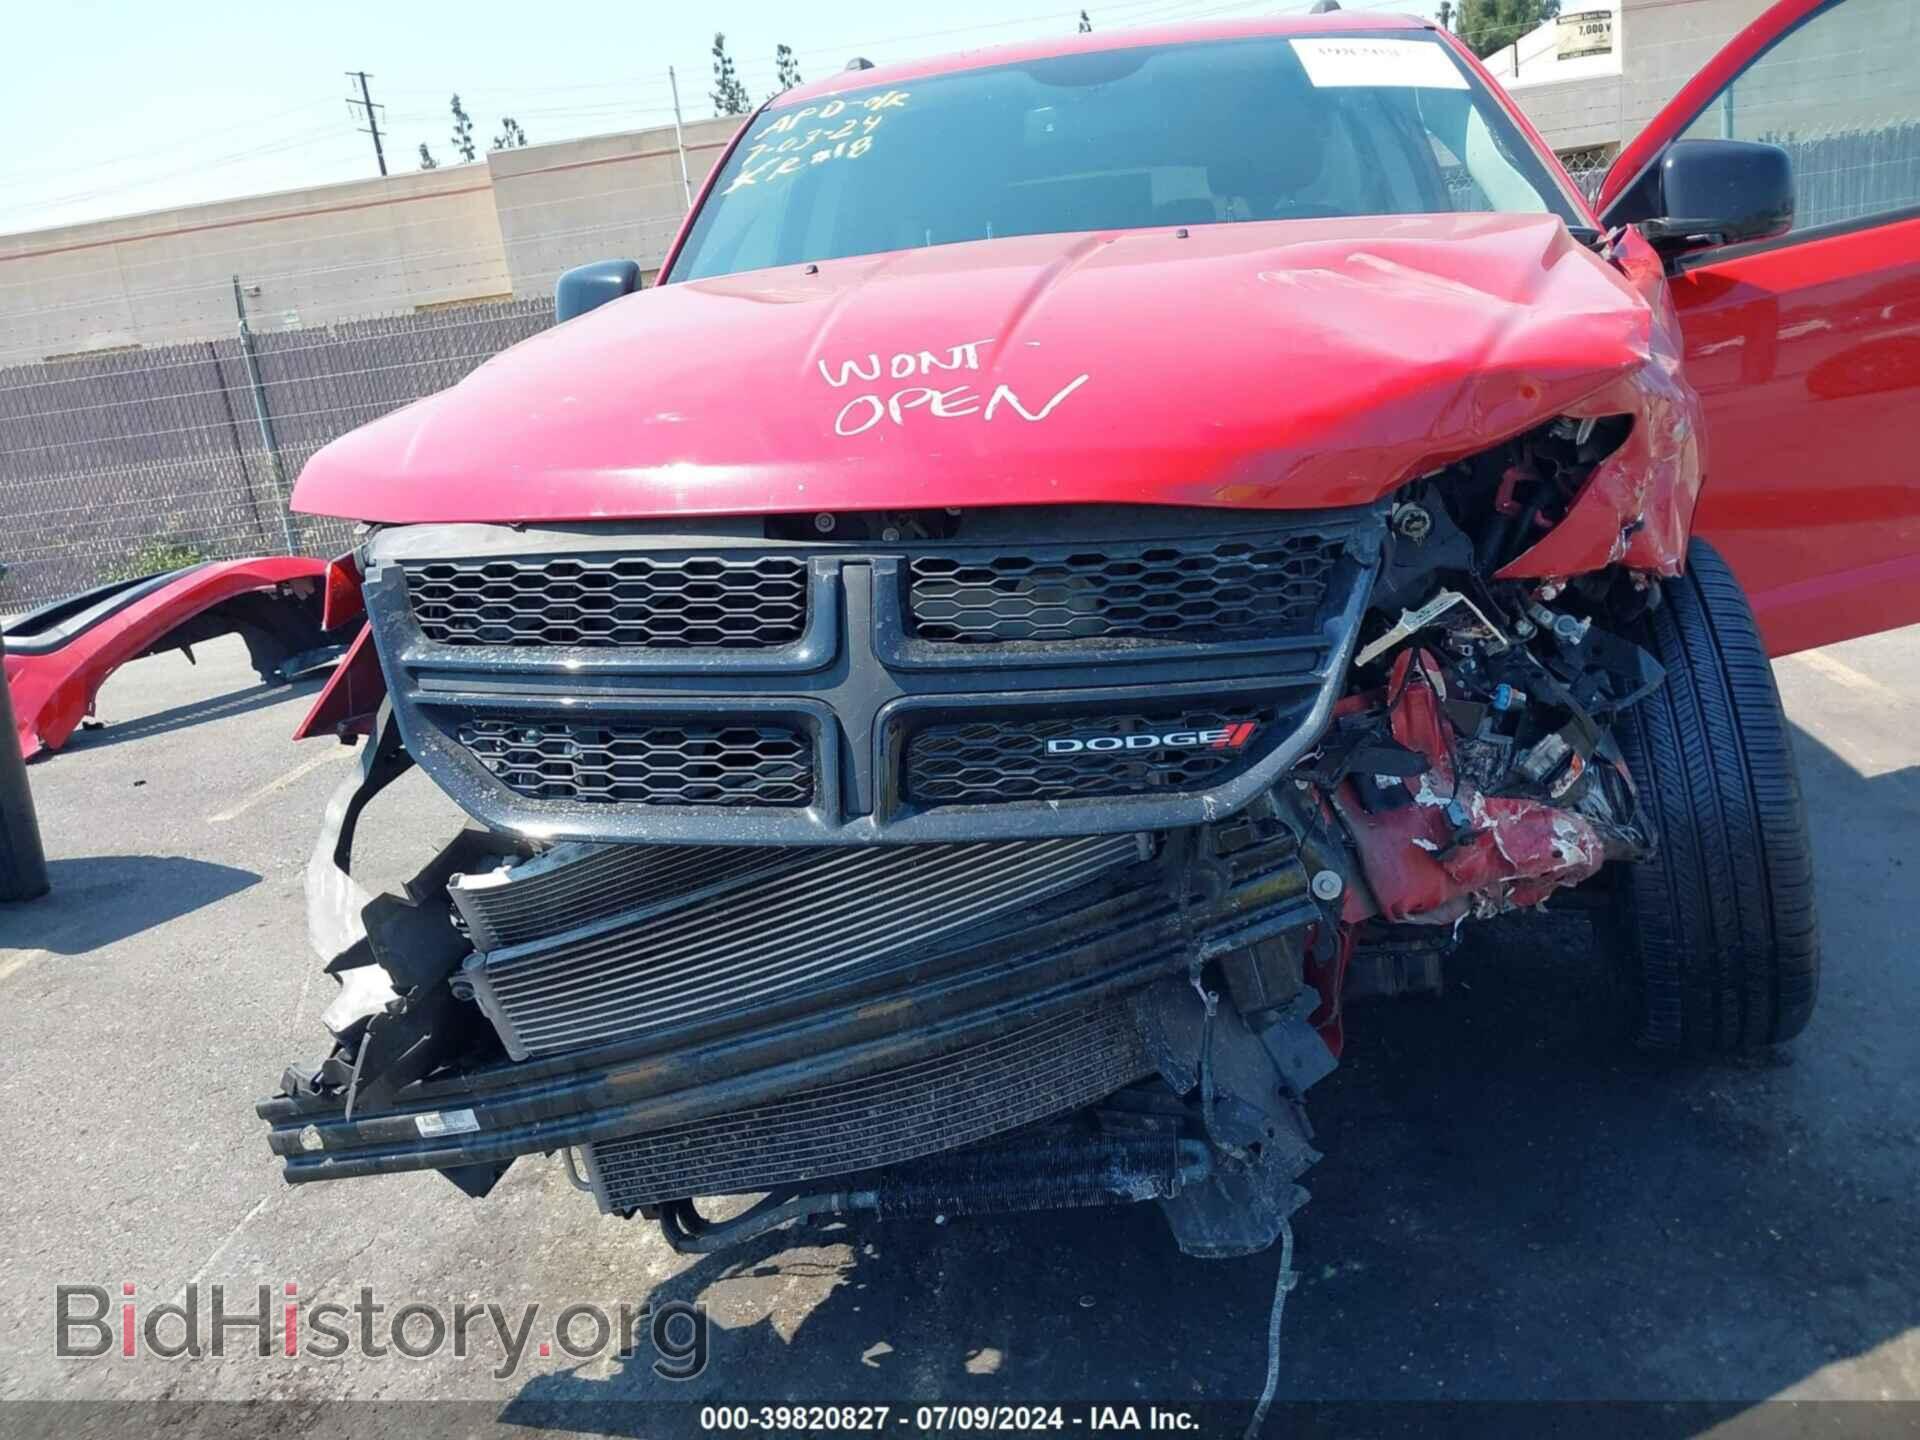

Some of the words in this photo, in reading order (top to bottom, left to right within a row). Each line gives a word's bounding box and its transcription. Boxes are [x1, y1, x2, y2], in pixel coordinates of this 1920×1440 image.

[817, 337, 996, 387] WONT
[834, 373, 1089, 436] OPEN
[1047, 729, 1230, 753] DODGE
